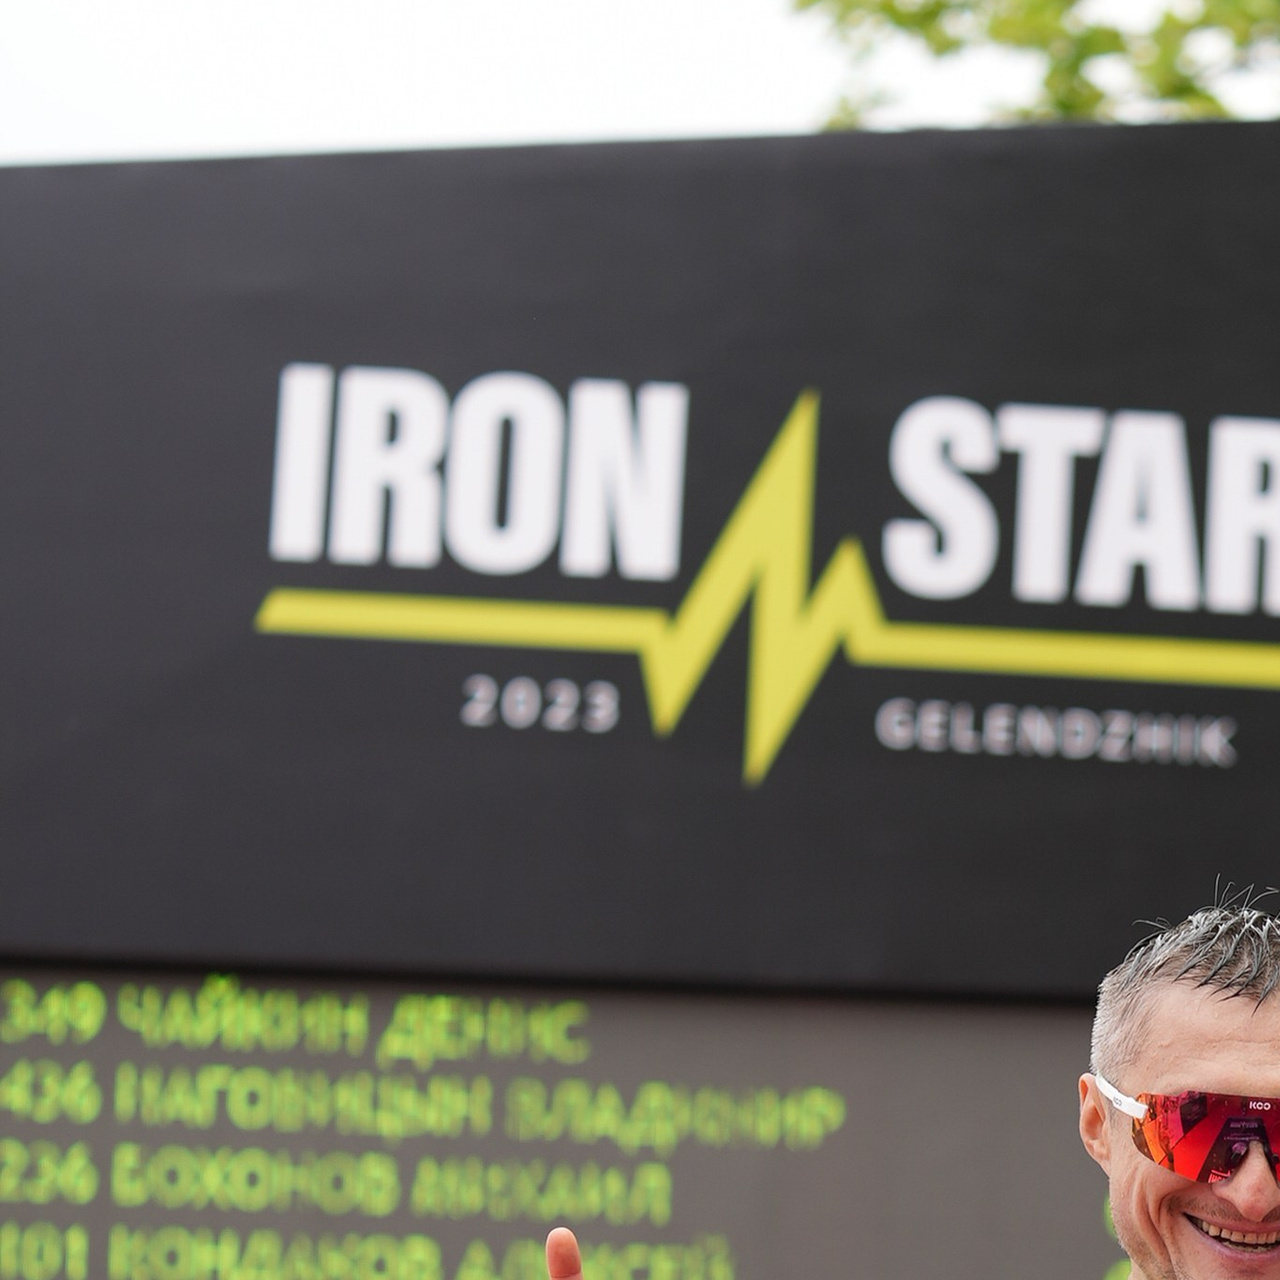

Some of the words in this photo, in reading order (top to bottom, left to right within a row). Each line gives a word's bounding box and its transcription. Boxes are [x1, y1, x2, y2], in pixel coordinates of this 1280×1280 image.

[268, 362, 689, 582] IRON
[460, 674, 620, 733] 2023
[876, 698, 1237, 766] GELENDZHIK
